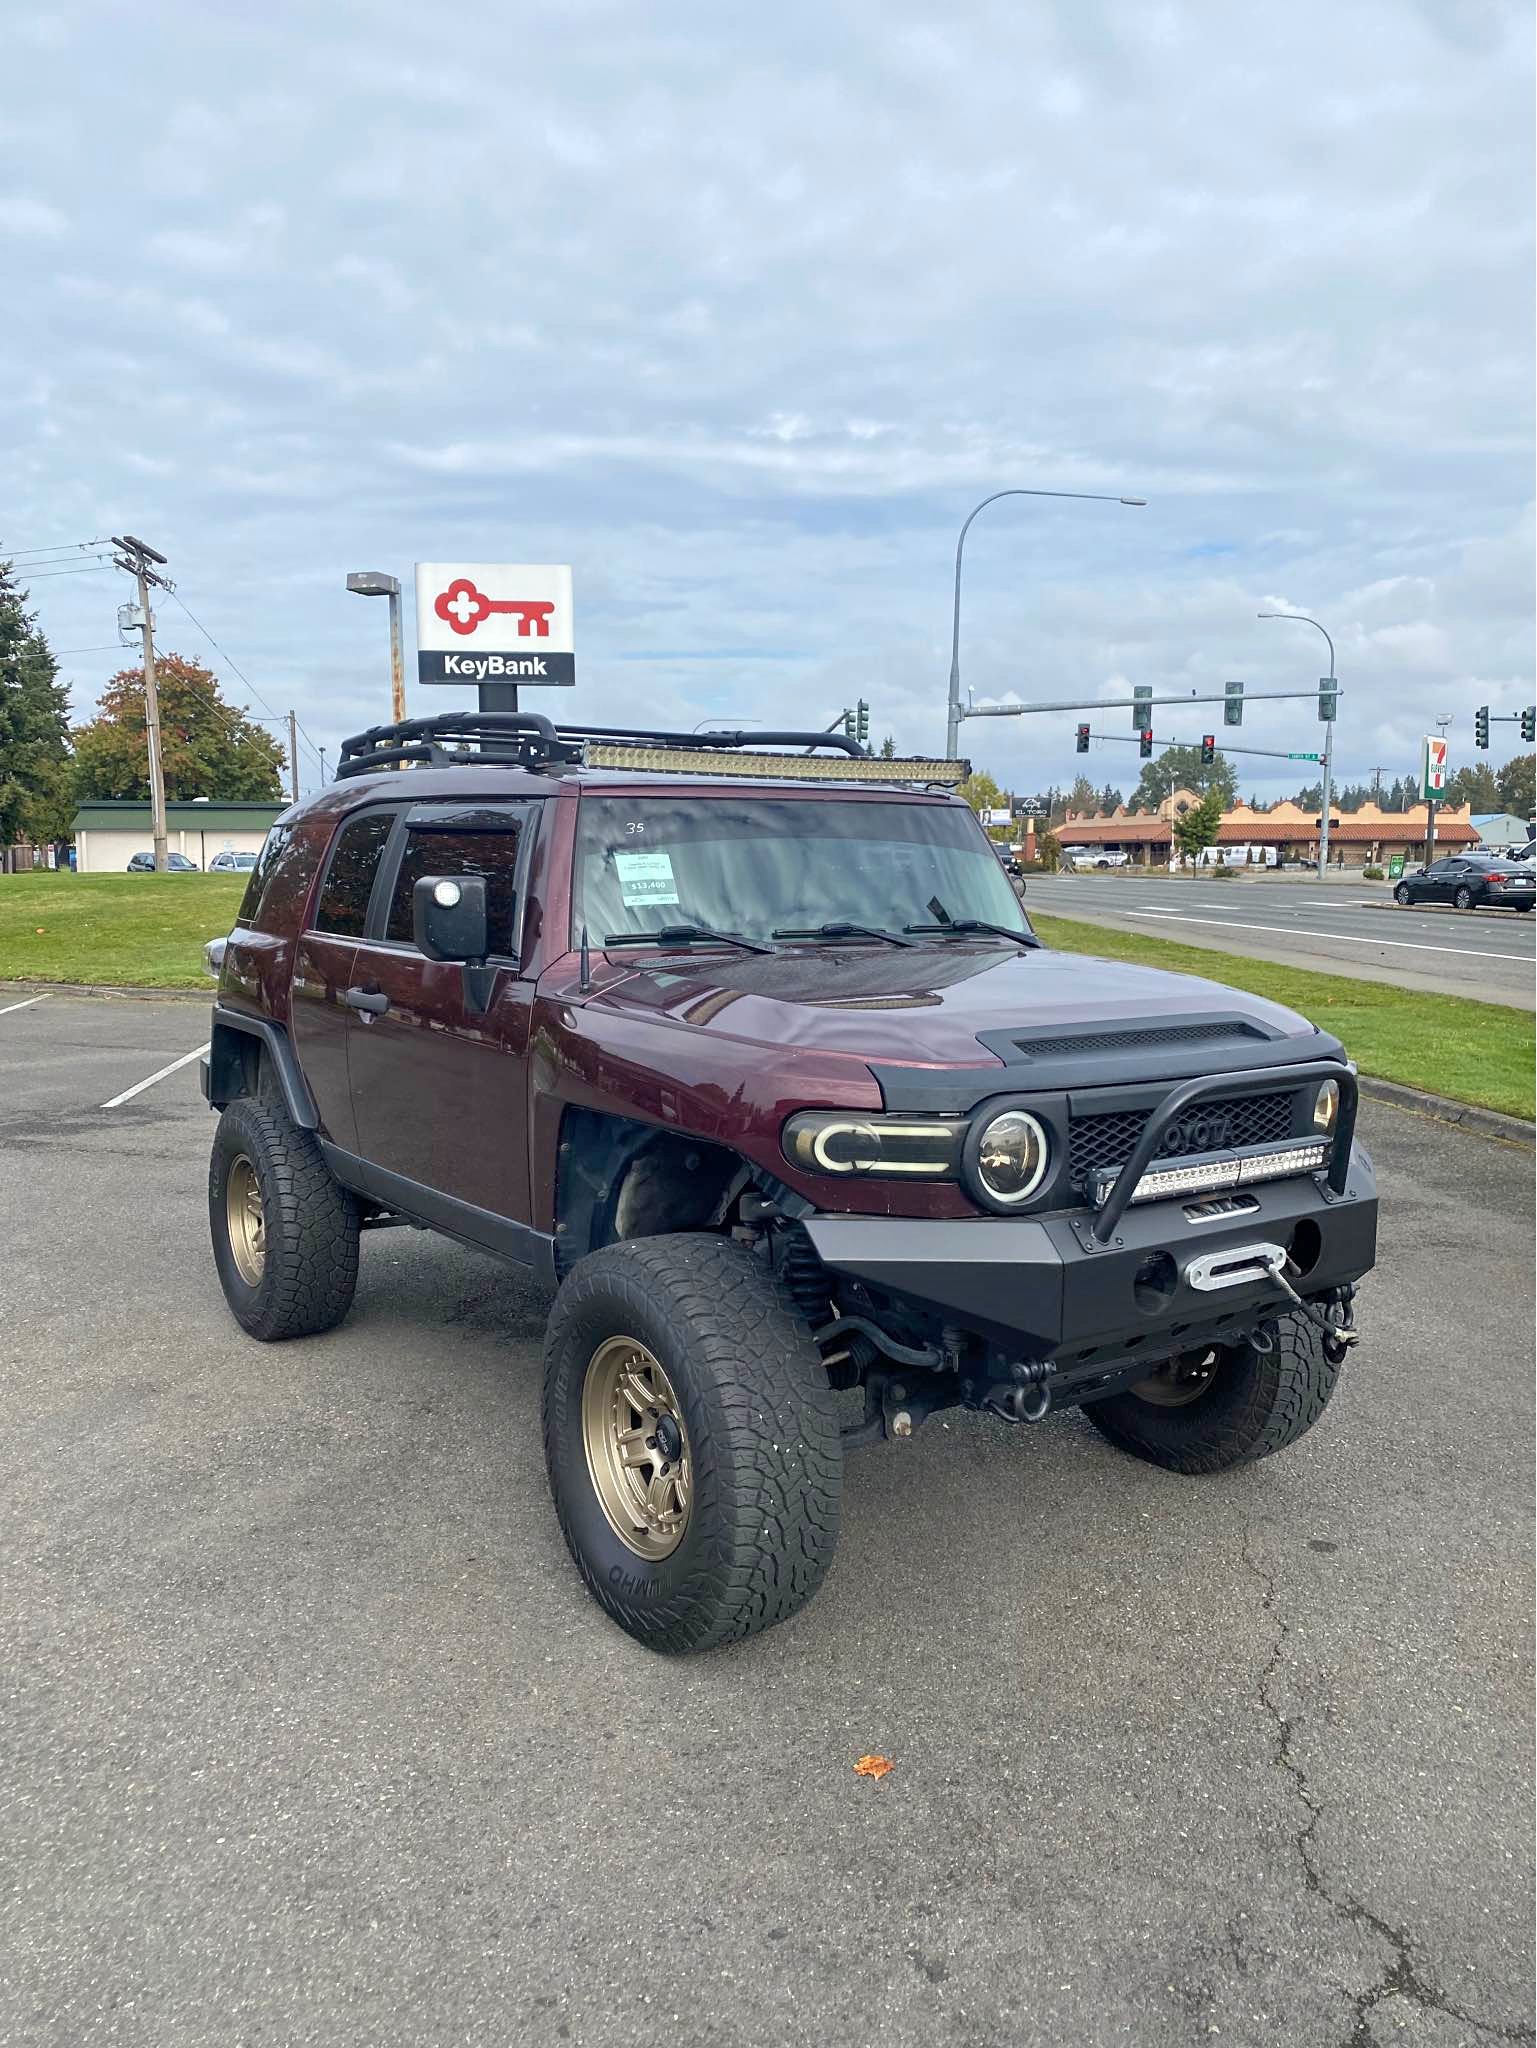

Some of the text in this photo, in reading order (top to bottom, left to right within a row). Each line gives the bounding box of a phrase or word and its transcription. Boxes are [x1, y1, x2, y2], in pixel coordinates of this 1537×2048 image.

[444, 655, 547, 679] KeyBank
[625, 822, 645, 834] 35
[1164, 1119, 1232, 1151] OYOTA
